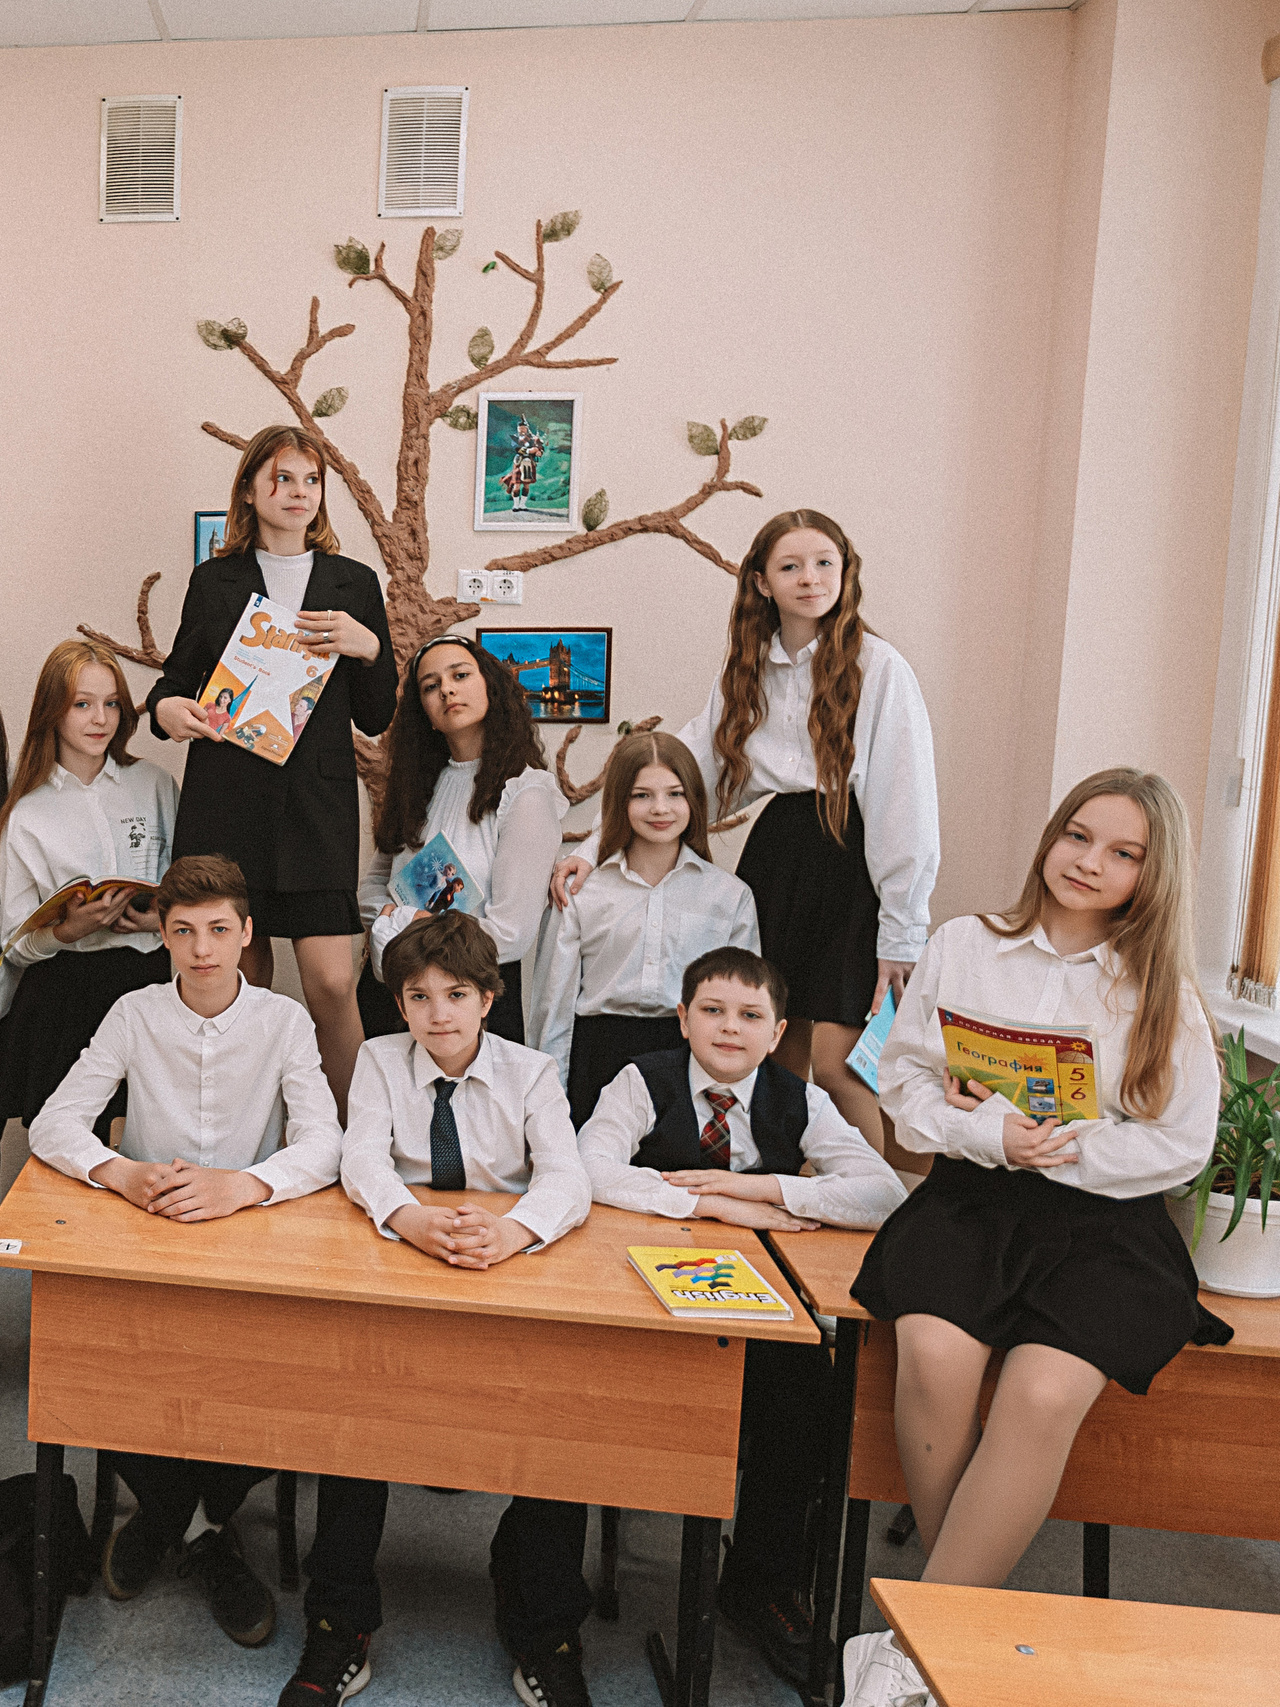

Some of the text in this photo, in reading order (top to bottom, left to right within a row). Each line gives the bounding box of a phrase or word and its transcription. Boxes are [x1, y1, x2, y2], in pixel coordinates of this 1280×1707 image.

[305, 665, 319, 678] 6
[120, 817, 135, 825] NEW
[956, 1041, 1044, 1074] География
[1069, 1067, 1086, 1082] 5
[1070, 1087, 1087, 1101] 6
[671, 1289, 778, 1304] English
